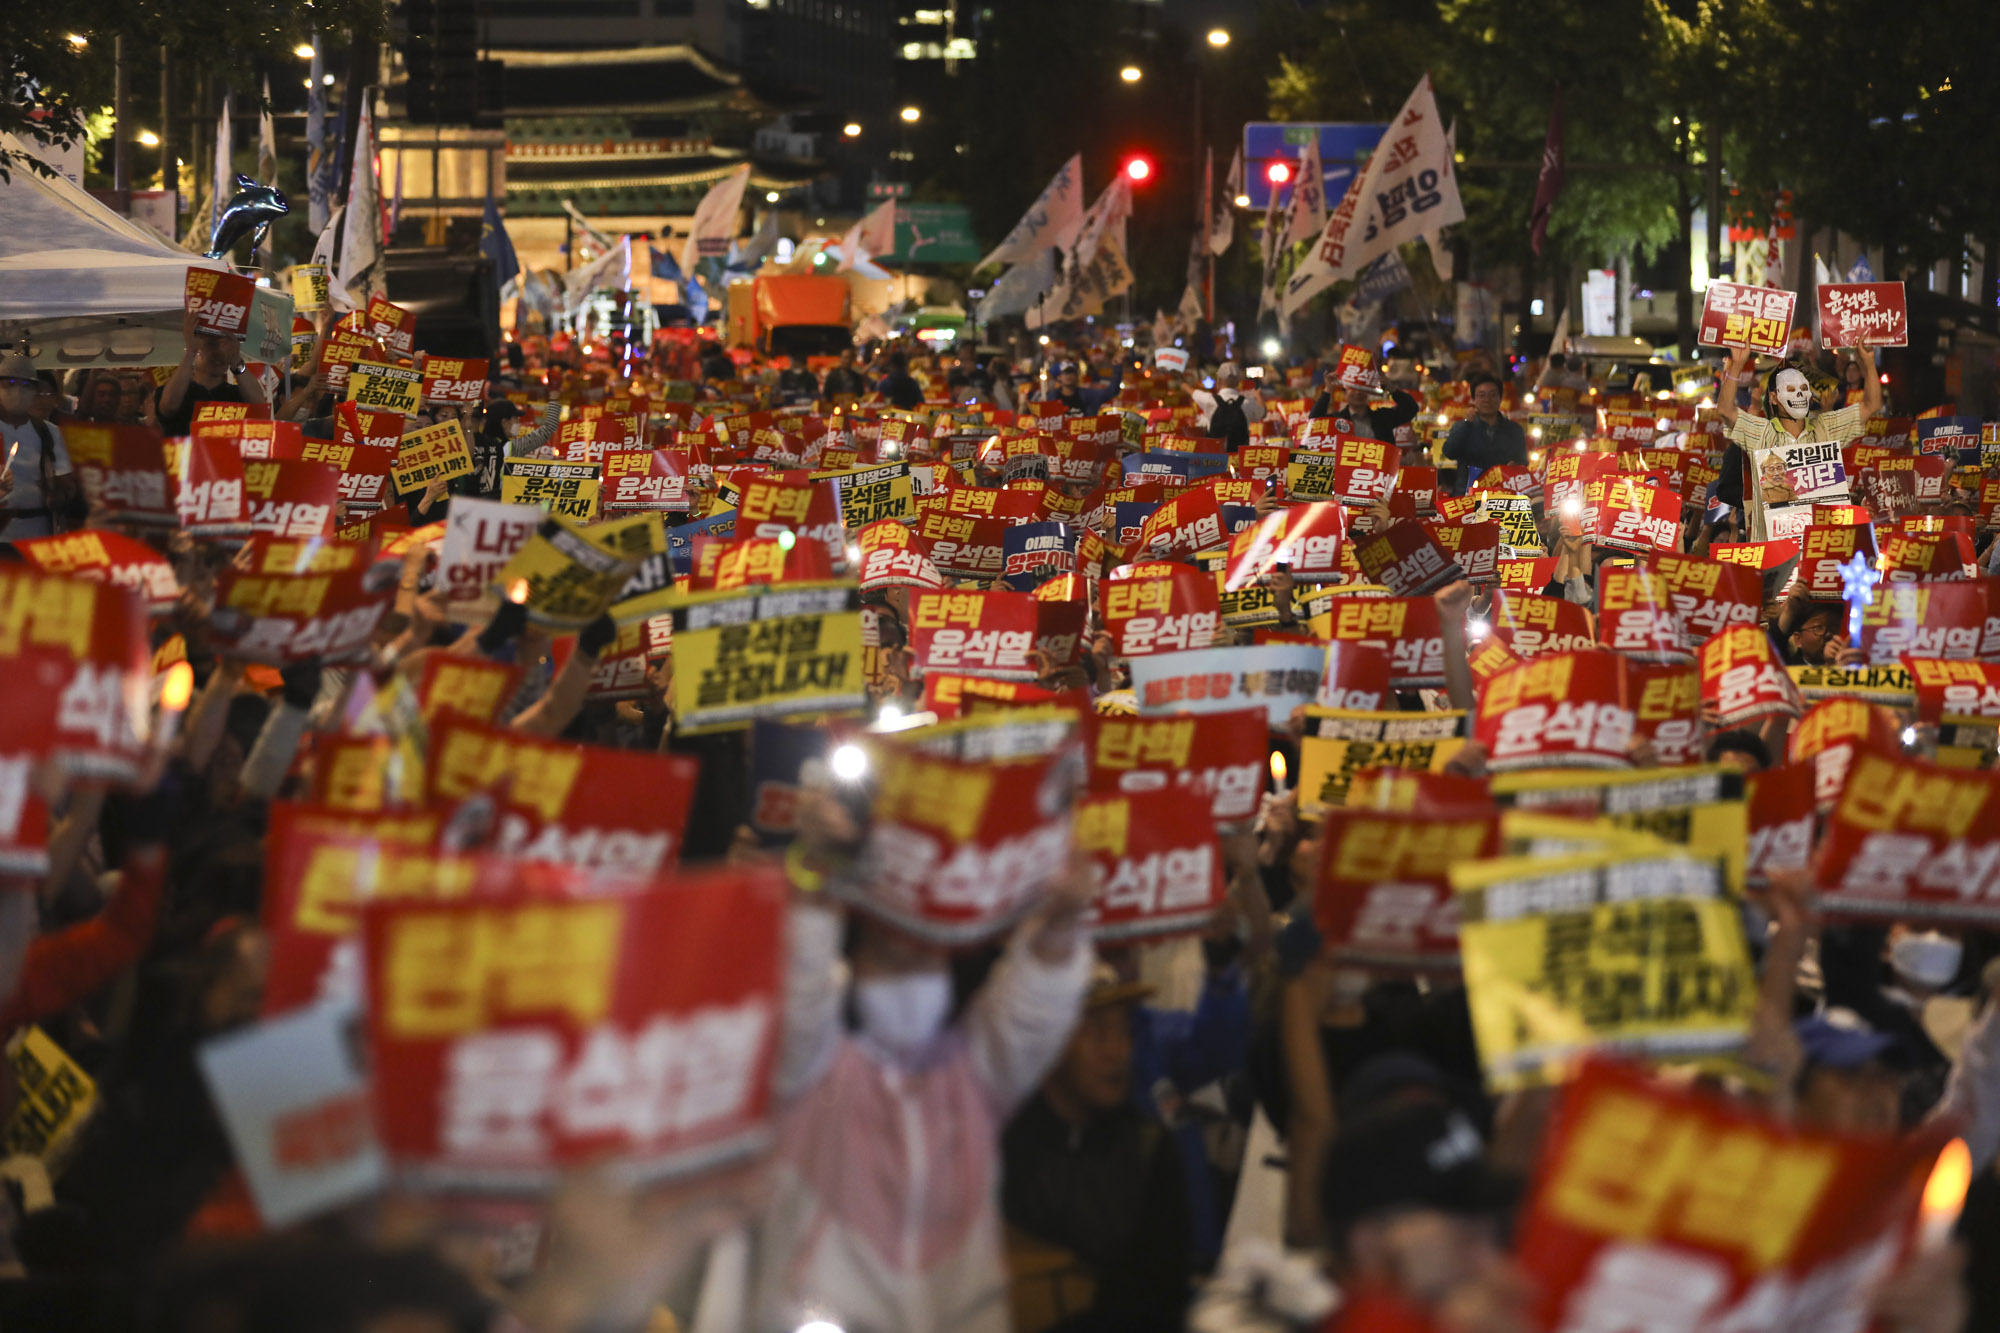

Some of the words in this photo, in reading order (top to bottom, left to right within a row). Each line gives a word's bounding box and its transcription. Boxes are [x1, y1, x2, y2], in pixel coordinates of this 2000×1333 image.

[1709, 285, 1790, 322] 윤석열
[1825, 289, 1879, 315] 윤석열을
[1723, 314, 1786, 347] 퇴진!
[1840, 308, 1901, 334] 몰아내자!
[322, 344, 361, 363] 탄핵
[1342, 347, 1372, 367] 탄핵
[425, 358, 466, 380] 탄핵
[365, 376, 409, 394] 윤석열
[429, 376, 485, 400] 윤석열
[356, 389, 415, 411] 끝장내자!
[425, 425, 457, 443] 133호
[561, 421, 597, 443] 탄핵
[1612, 425, 1654, 441] 윤석열
[1921, 434, 1979, 454] 항쟁이다
[1934, 425, 1963, 436] 이제는
[302, 442, 355, 470] 탄핵
[431, 437, 463, 458] 수사
[1057, 441, 1073, 457] 핵
[1243, 448, 1279, 467] 탄핵
[1340, 440, 1386, 469] 탄핵
[1785, 442, 1839, 468] 친일파
[398, 456, 467, 488] 언제합니까?
[511, 464, 547, 477] 범국민
[549, 465, 594, 479] 항쟁으로
[607, 453, 652, 477] 탄핵
[855, 464, 902, 485] 항쟁으로
[1062, 459, 1094, 477] 석열
[1546, 456, 1580, 485] 탄핵
[1793, 463, 1836, 491] 처단
[245, 463, 281, 498] 핵
[337, 474, 384, 498] 석열
[523, 478, 581, 497] 윤석열
[616, 475, 686, 500] 윤석열
[1214, 481, 1252, 502] 탄핵
[1347, 468, 1397, 498] 윤석
[1503, 473, 1532, 491] 석열
[176, 480, 242, 522] 석열
[741, 484, 813, 523] 탄핵
[951, 488, 998, 514] 탄핵
[1043, 489, 1085, 513] 탄핵
[1485, 500, 1509, 511] 국민
[1607, 483, 1655, 513] 탄핵
[254, 502, 330, 537] 석열
[843, 497, 906, 529] 장내자!
[1144, 501, 1178, 534] 탄핵
[861, 522, 909, 554] 탄핵
[923, 514, 976, 542] 탄핵
[1150, 513, 1221, 557] 윤석열
[1437, 527, 1463, 550] 핵
[1611, 510, 1677, 548] 윤석열
[930, 540, 1003, 571] 윤석열
[1025, 535, 1065, 550] 이제는
[1806, 529, 1857, 558] 탄핵
[1887, 538, 1936, 571] 탄핵
[716, 542, 787, 588] 탄핵
[864, 549, 942, 580] 윤석열
[1452, 546, 1497, 574] 석열
[1717, 546, 1765, 569] 탄핵
[1496, 562, 1535, 587] 탄핵
[1656, 556, 1722, 595] 탄핵
[1107, 580, 1173, 619] 탄핵
[1603, 573, 1668, 609] 탄핵
[916, 594, 985, 628] 탄핵
[1337, 602, 1407, 638] 탄핵
[1497, 597, 1558, 630] 탄핵
[1863, 588, 1930, 626] 탄핵
[1122, 611, 1217, 655] 윤석열
[1870, 627, 1981, 665] 윤석열
[928, 629, 1032, 666] 윤석열
[1390, 637, 1446, 673] 석열
[1704, 624, 1768, 681] 탄핵
[597, 654, 646, 687] 석열
[1914, 660, 1986, 685] 탄핵
[1483, 655, 1575, 718] 탄핵
[1493, 702, 1636, 757] 윤석열
[1100, 845, 1214, 913] 석열
